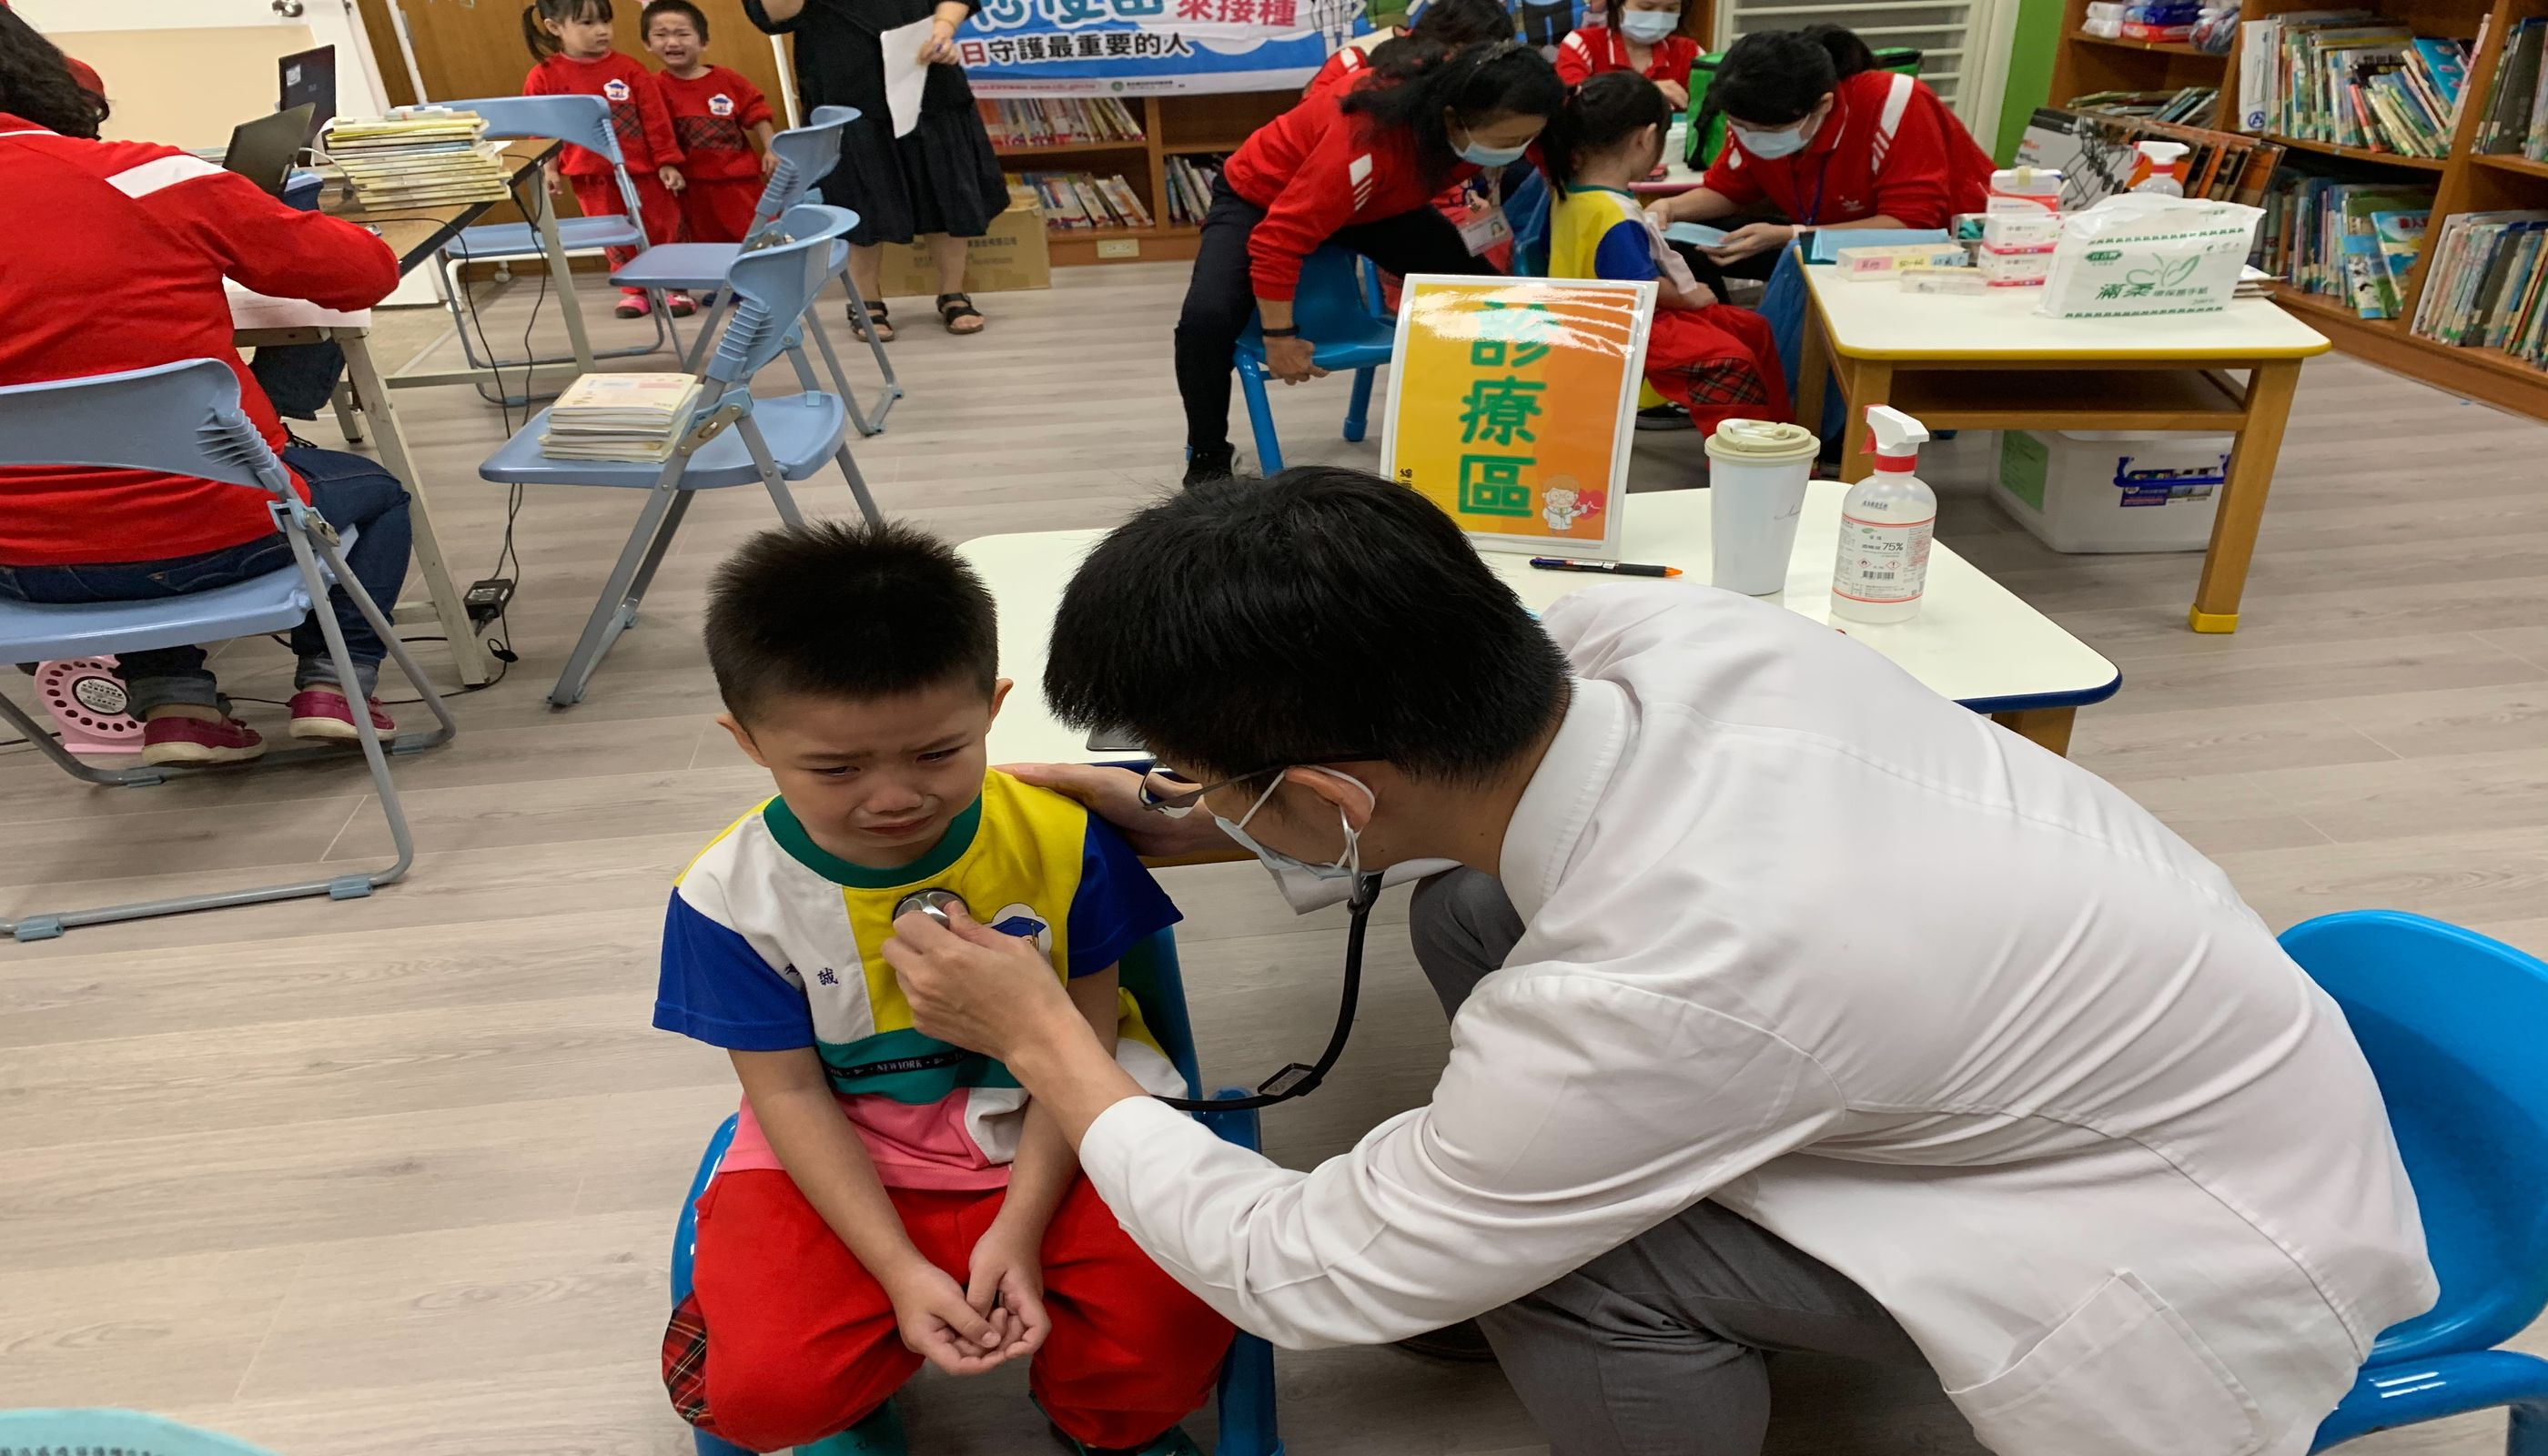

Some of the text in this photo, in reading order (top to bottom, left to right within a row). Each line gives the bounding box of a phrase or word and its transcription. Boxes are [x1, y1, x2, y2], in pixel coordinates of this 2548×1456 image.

[961, 32, 1190, 65] 日守護最重要的人
[1882, 542, 1904, 551] 75%
